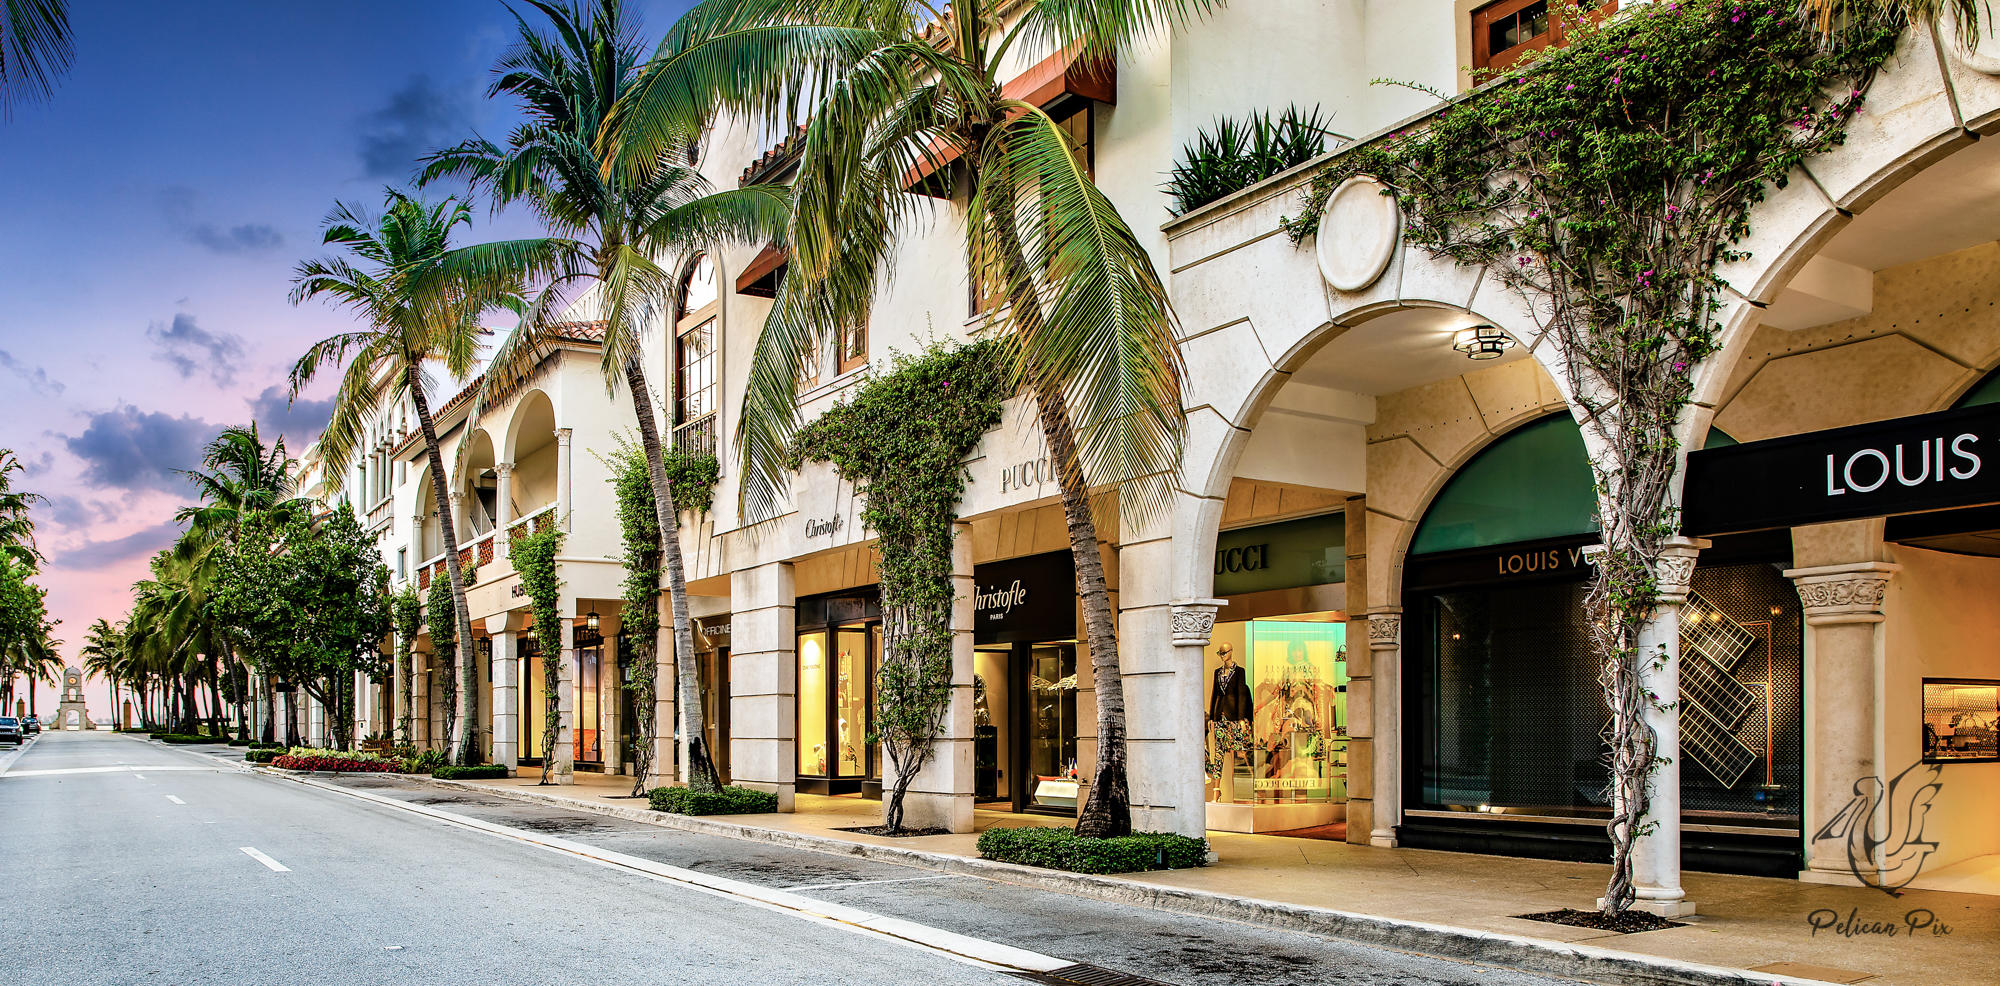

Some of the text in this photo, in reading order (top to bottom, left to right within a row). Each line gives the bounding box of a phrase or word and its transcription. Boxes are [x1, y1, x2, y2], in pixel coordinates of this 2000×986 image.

[1000, 455, 1054, 494] PUCCI
[1826, 433, 1982, 496] LOUIS
[805, 513, 844, 539] Christofle
[1214, 543, 1270, 576] UCCI
[1498, 550, 1559, 574] LOUIS
[974, 579, 1027, 614] hristofle
[989, 613, 1004, 621] PARIS
